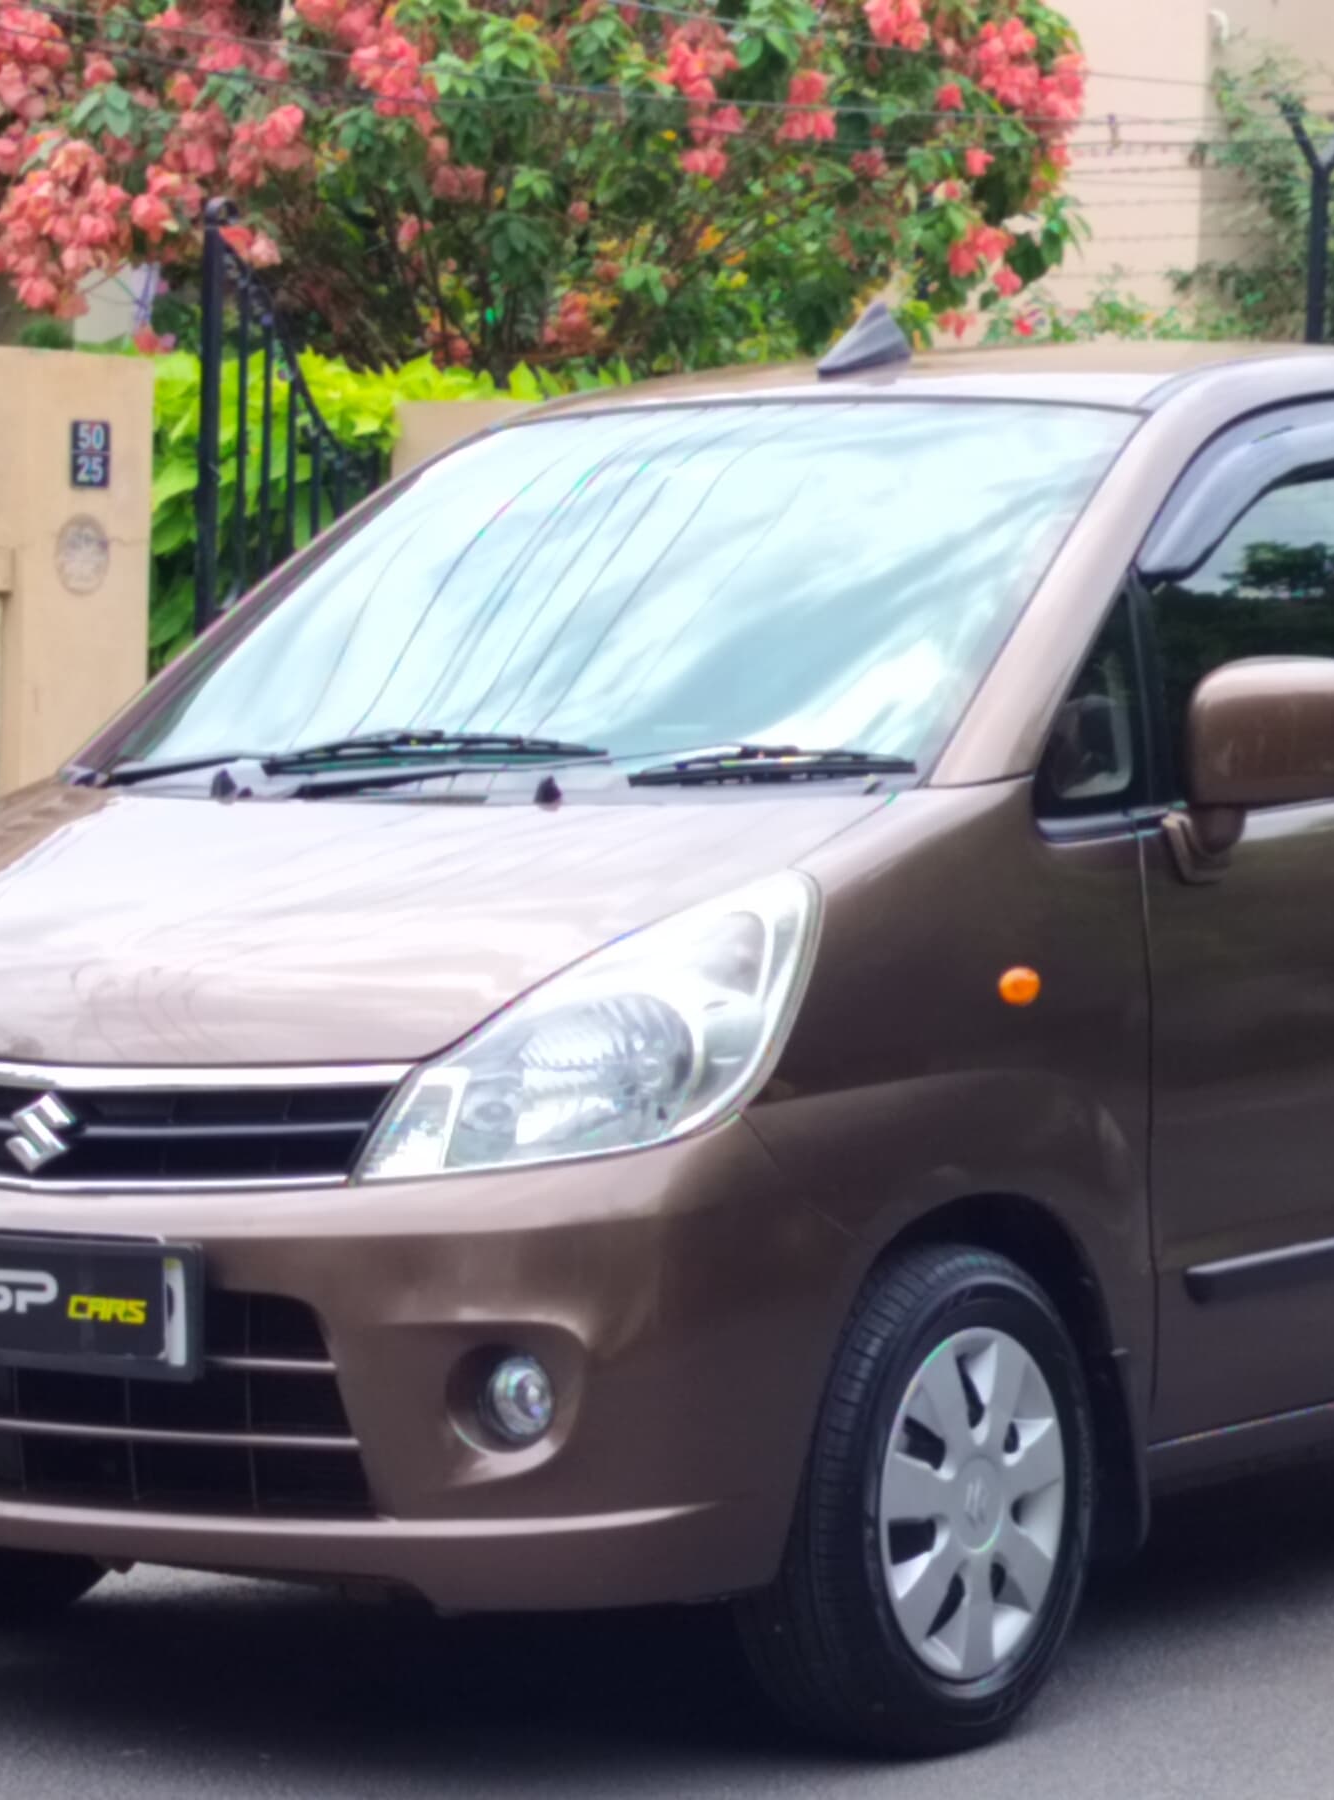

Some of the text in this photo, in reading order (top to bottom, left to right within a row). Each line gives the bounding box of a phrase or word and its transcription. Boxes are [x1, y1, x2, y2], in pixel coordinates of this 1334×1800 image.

[77, 423, 105, 450] 50
[76, 455, 104, 482] 25
[67, 1294, 147, 1324] CARS
